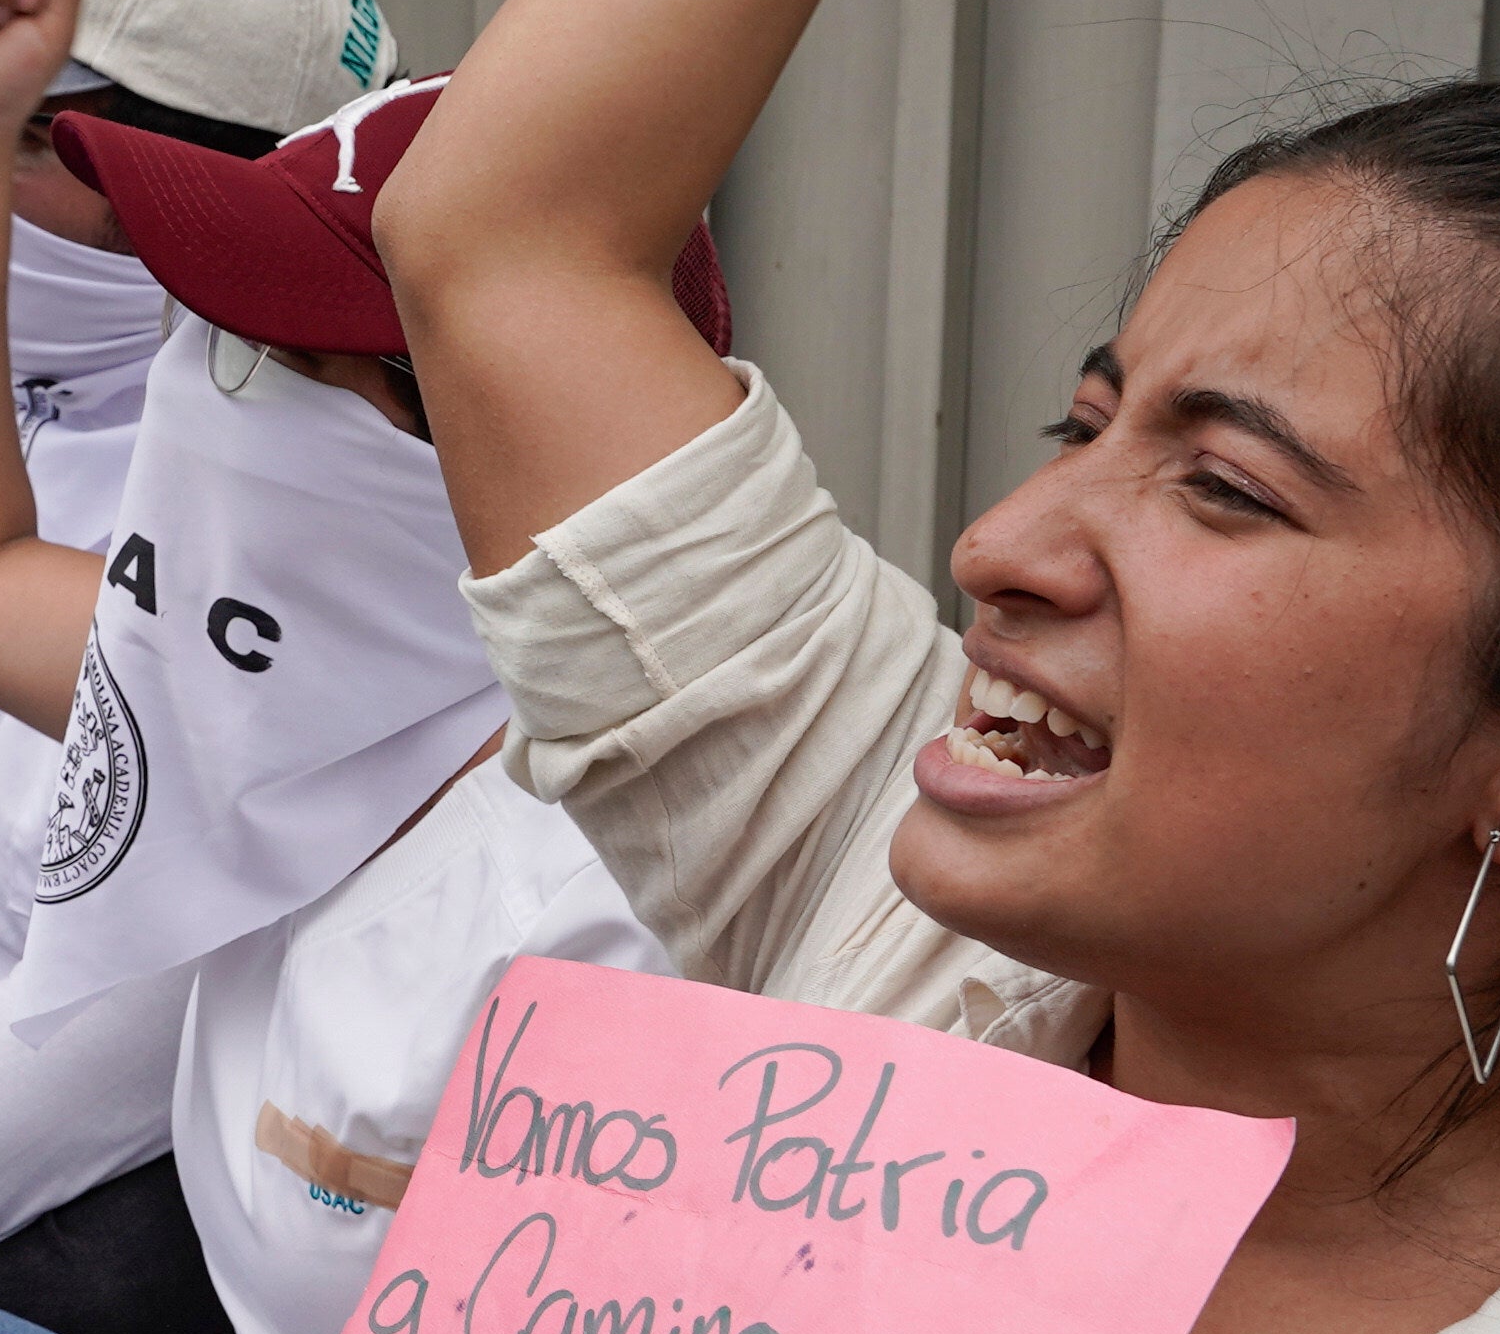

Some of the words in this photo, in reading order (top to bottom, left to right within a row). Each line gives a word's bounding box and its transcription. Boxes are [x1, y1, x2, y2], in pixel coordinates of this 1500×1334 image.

[103, 739, 130, 841] ACADEMIA
[39, 841, 107, 890] COACTEM
[458, 996, 678, 1192] Vamos
[718, 1041, 1048, 1252] Patria
[309, 1183, 365, 1215] USAC
